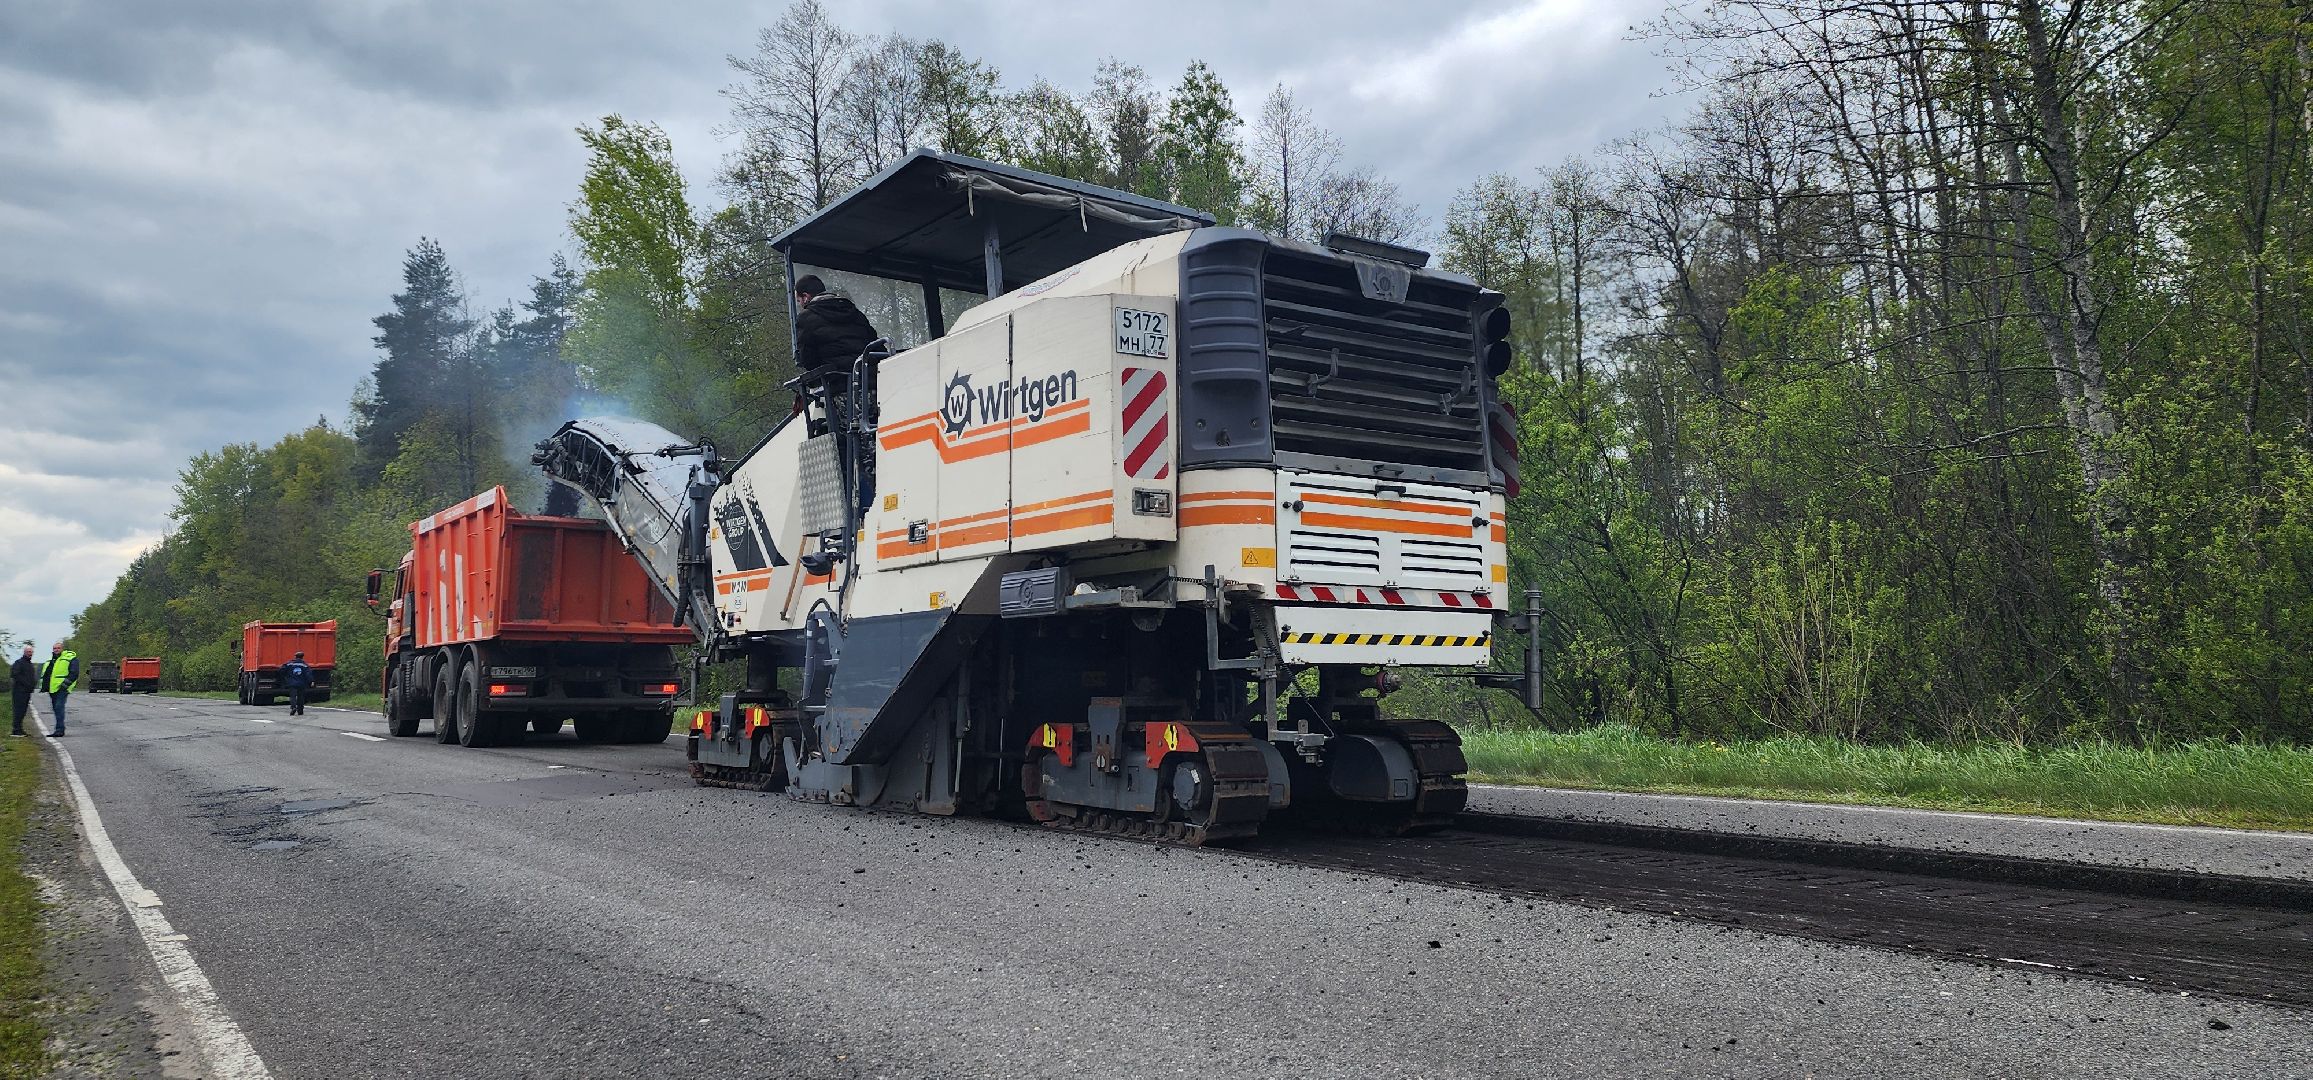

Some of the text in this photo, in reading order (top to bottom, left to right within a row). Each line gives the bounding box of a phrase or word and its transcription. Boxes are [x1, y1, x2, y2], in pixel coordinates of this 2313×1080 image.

[1123, 311, 1161, 333] 5172
[1150, 335, 1164, 350] 77
[951, 369, 1077, 423] W Wirtgen
